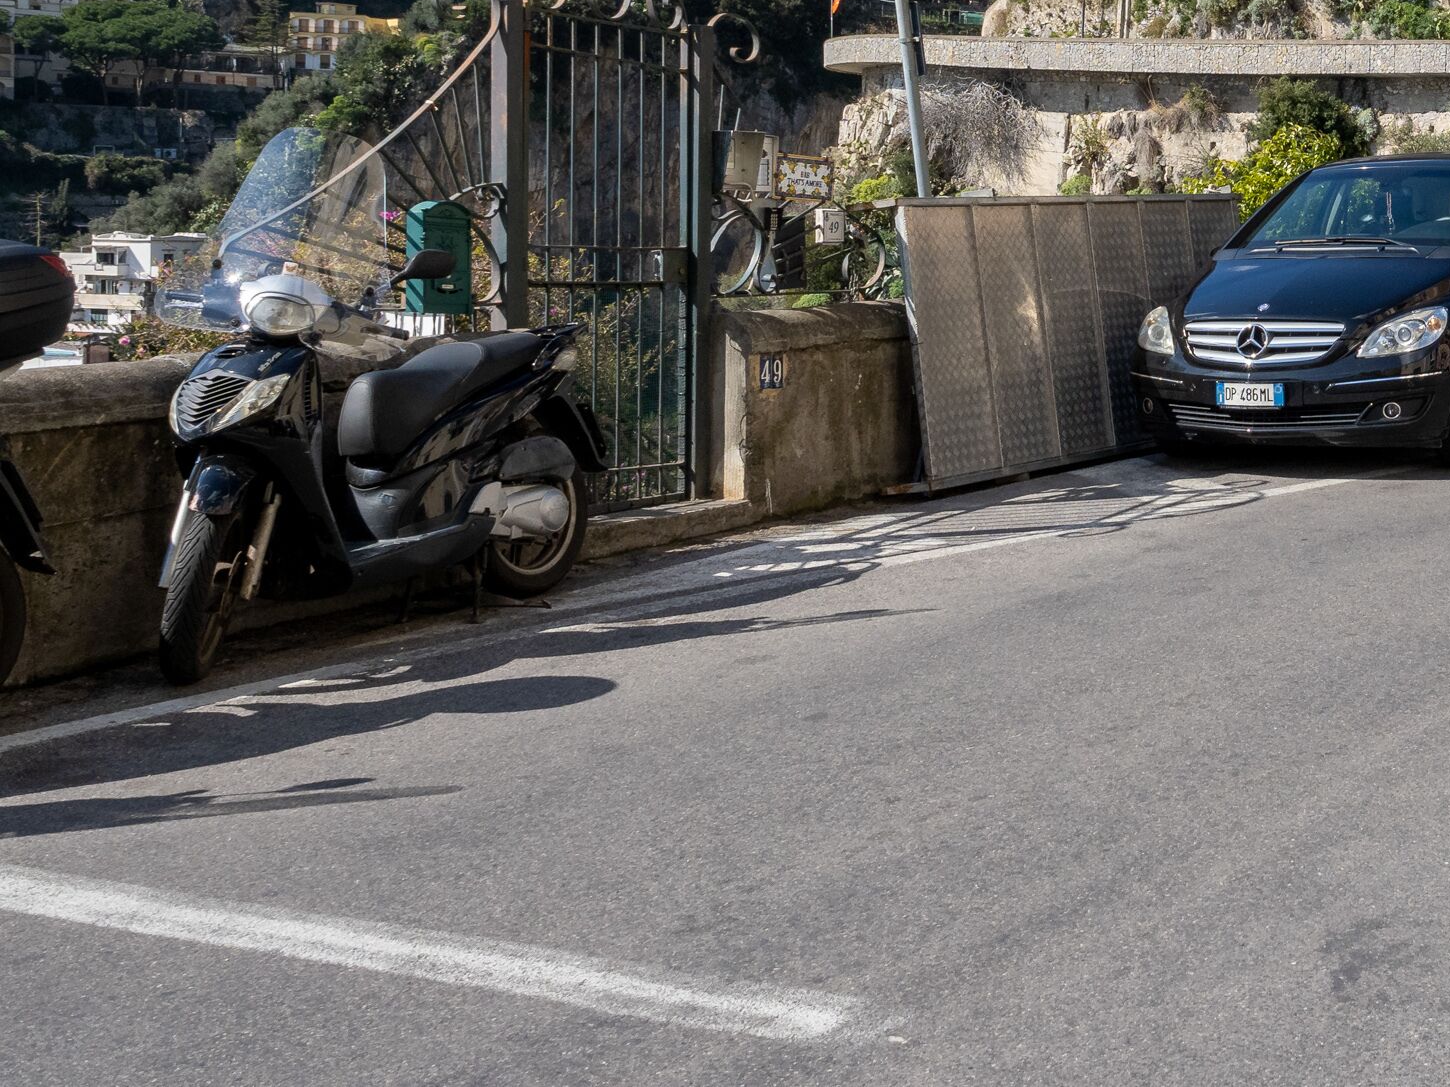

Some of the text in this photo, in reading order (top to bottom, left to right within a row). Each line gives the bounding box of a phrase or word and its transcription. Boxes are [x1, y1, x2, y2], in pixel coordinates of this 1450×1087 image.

[828, 220, 840, 234] 49
[761, 359, 782, 383] 49
[1225, 387, 1274, 402] DP 486ML
